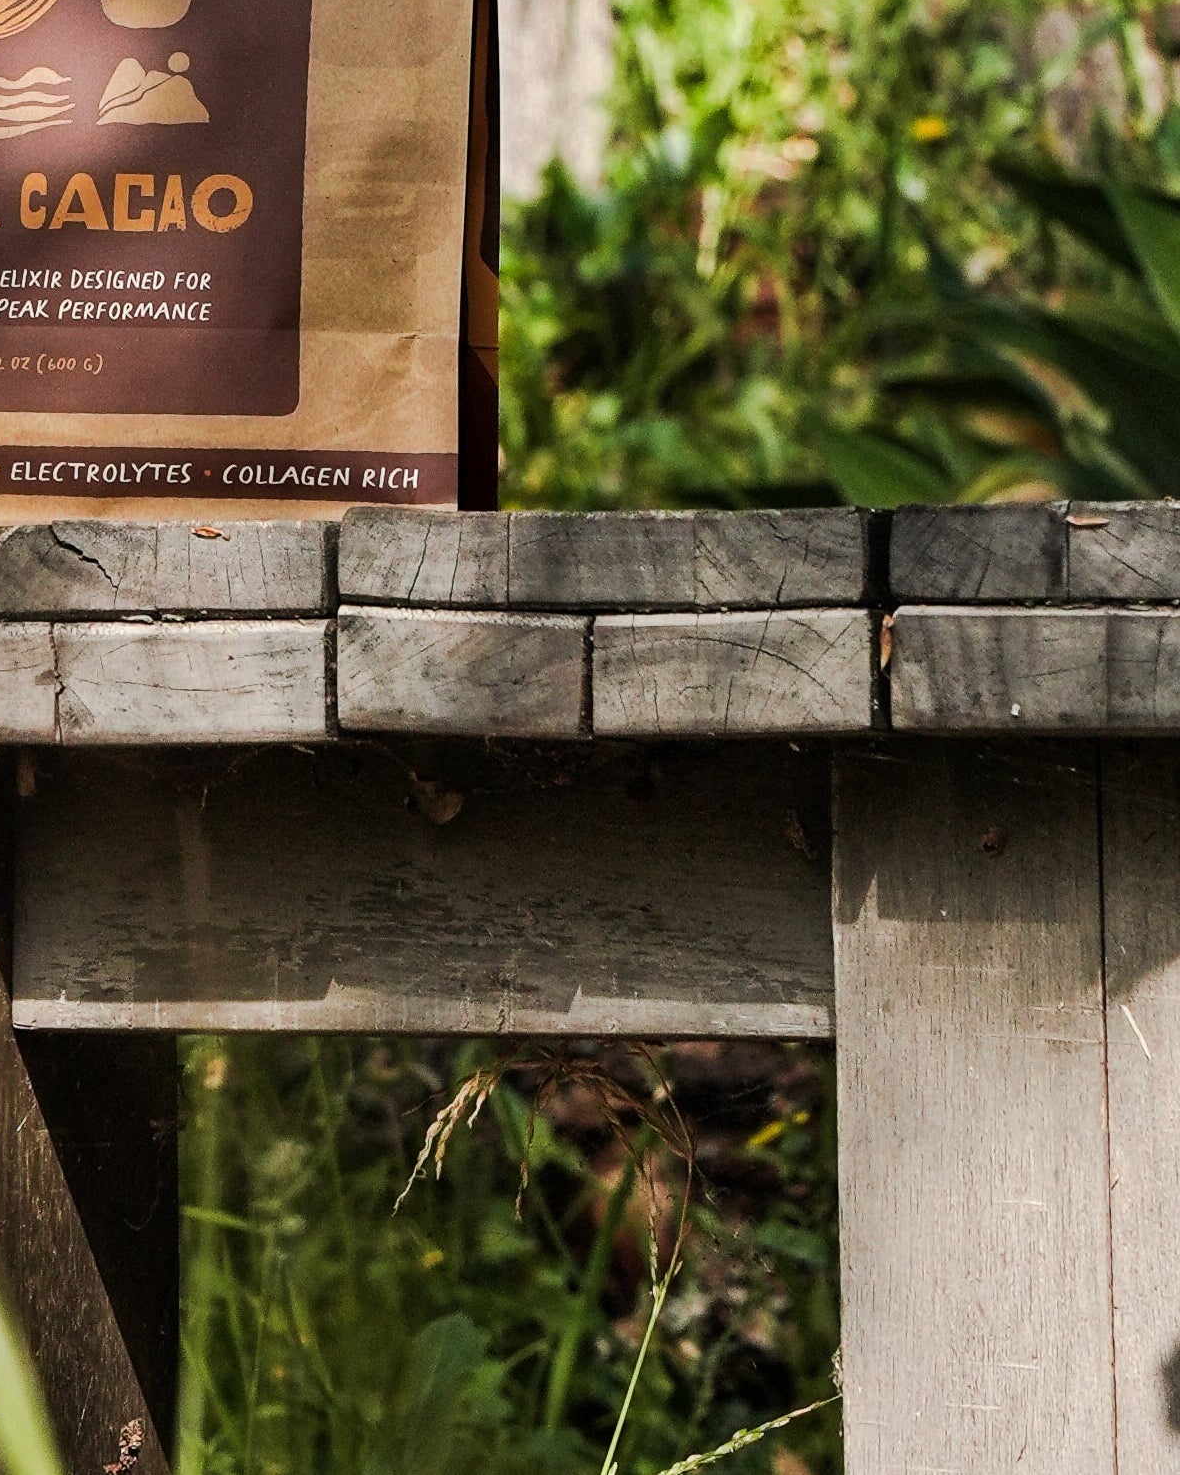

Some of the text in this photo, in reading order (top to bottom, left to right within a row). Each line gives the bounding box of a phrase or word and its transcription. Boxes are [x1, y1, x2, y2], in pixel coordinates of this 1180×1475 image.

[20, 172, 253, 233] CACAO
[0, 269, 62, 289] ELIXIR
[70, 270, 166, 291] DESIGNED
[173, 272, 212, 291] FOR
[58, 300, 212, 322] PERFORMANCE
[36, 353, 77, 374] (600
[83, 353, 104, 374] G)
[10, 461, 193, 485] ELECTROLYTES
[222, 463, 351, 487] COLLAGEN
[361, 467, 419, 489] RICH
